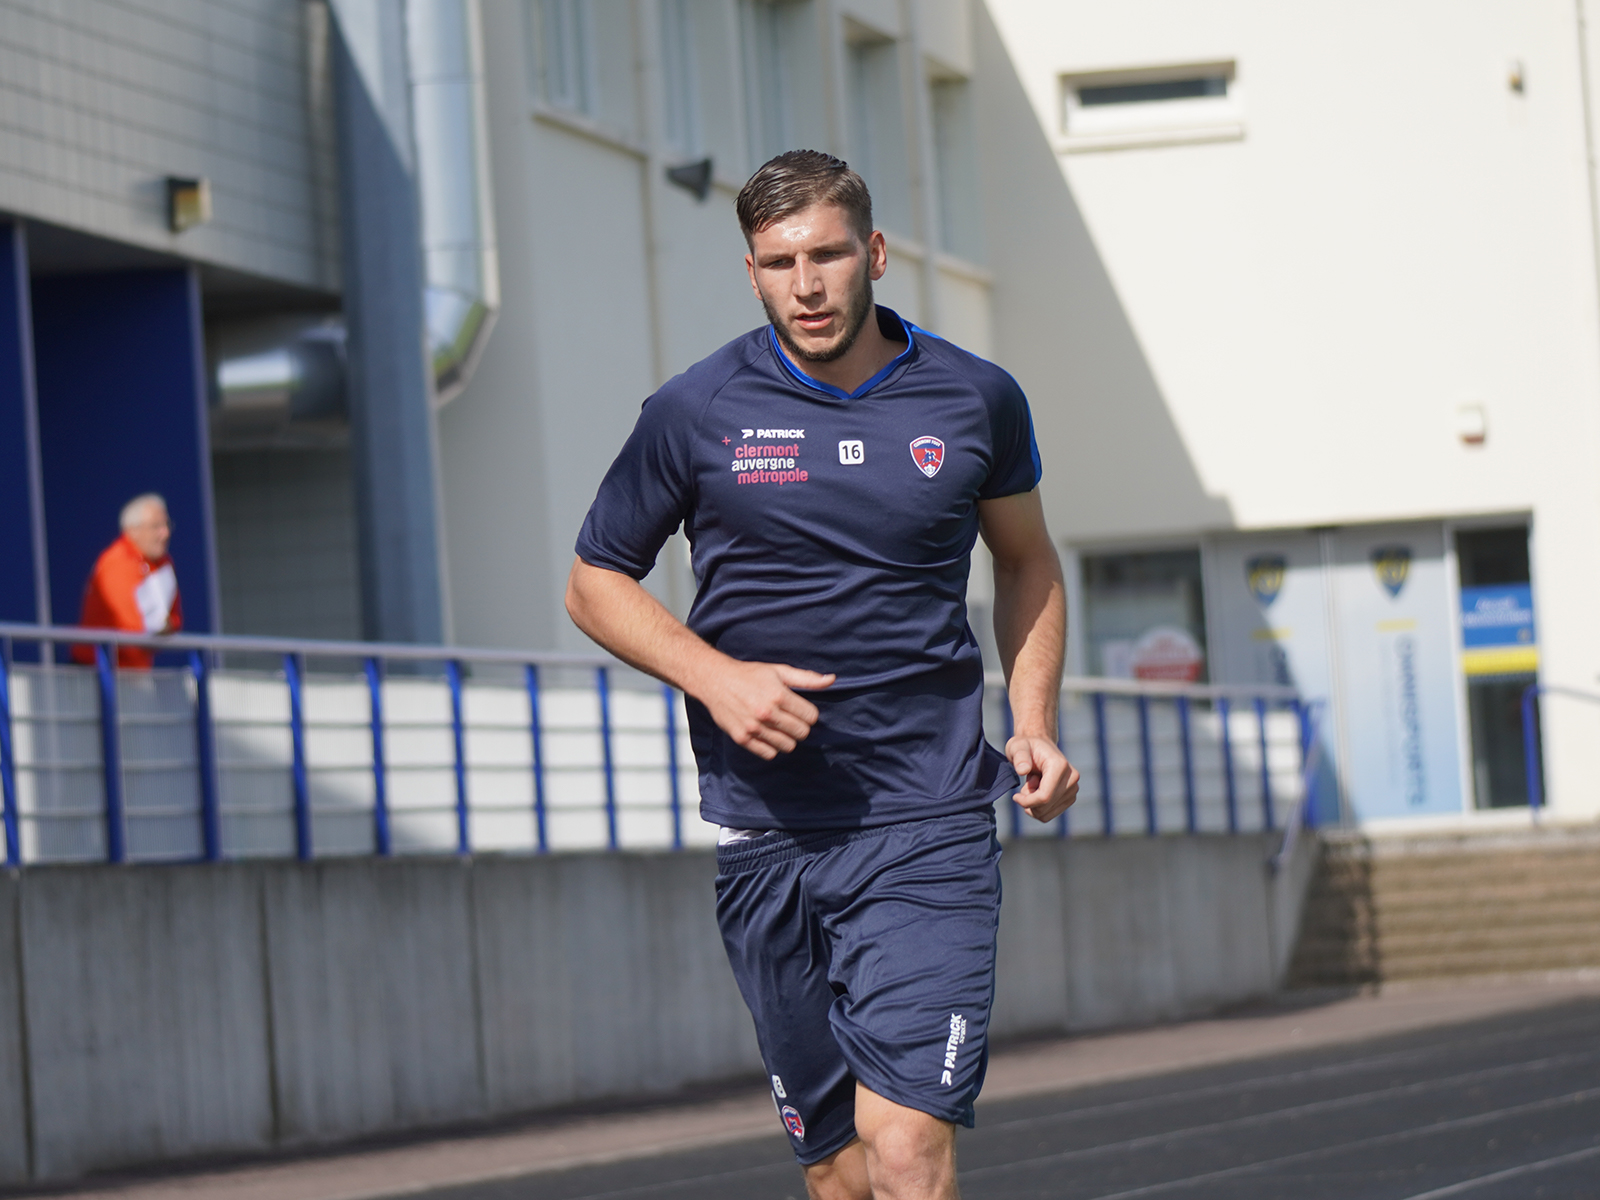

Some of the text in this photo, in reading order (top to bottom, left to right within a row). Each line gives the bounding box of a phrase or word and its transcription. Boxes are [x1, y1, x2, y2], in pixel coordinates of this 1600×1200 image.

[756, 428, 805, 439] PATRICK
[735, 443, 800, 459] clermont
[842, 444, 861, 460] 16
[731, 457, 795, 472] auvergne
[737, 467, 809, 486] métropole
[944, 1012, 962, 1069] PATRICK
